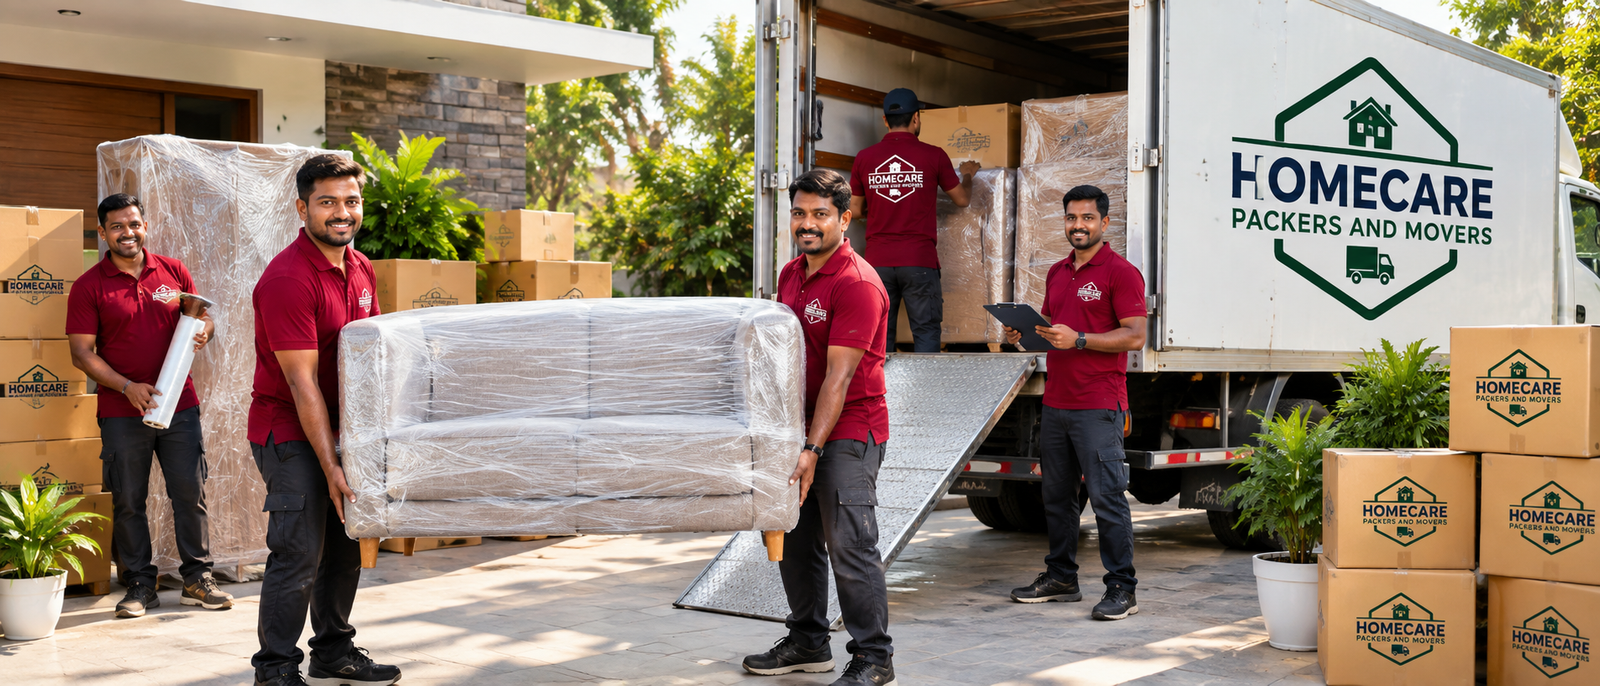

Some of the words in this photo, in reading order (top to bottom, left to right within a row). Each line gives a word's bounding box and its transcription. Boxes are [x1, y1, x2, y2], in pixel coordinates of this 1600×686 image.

[868, 174, 923, 185] HOMECARE
[1232, 152, 1493, 219] HOMECARE
[1232, 208, 1342, 235] PACKERS
[1349, 217, 1397, 238] AND
[1405, 221, 1493, 245] MOVERS
[9, 383, 68, 394] HOMECARE
[1476, 381, 1561, 395] HOMECARE
[1363, 504, 1448, 518] HOMECARE
[1509, 509, 1595, 527] HOMECARE
[1356, 621, 1445, 637] HOMECARE
[1512, 630, 1590, 655] HOMECARE
